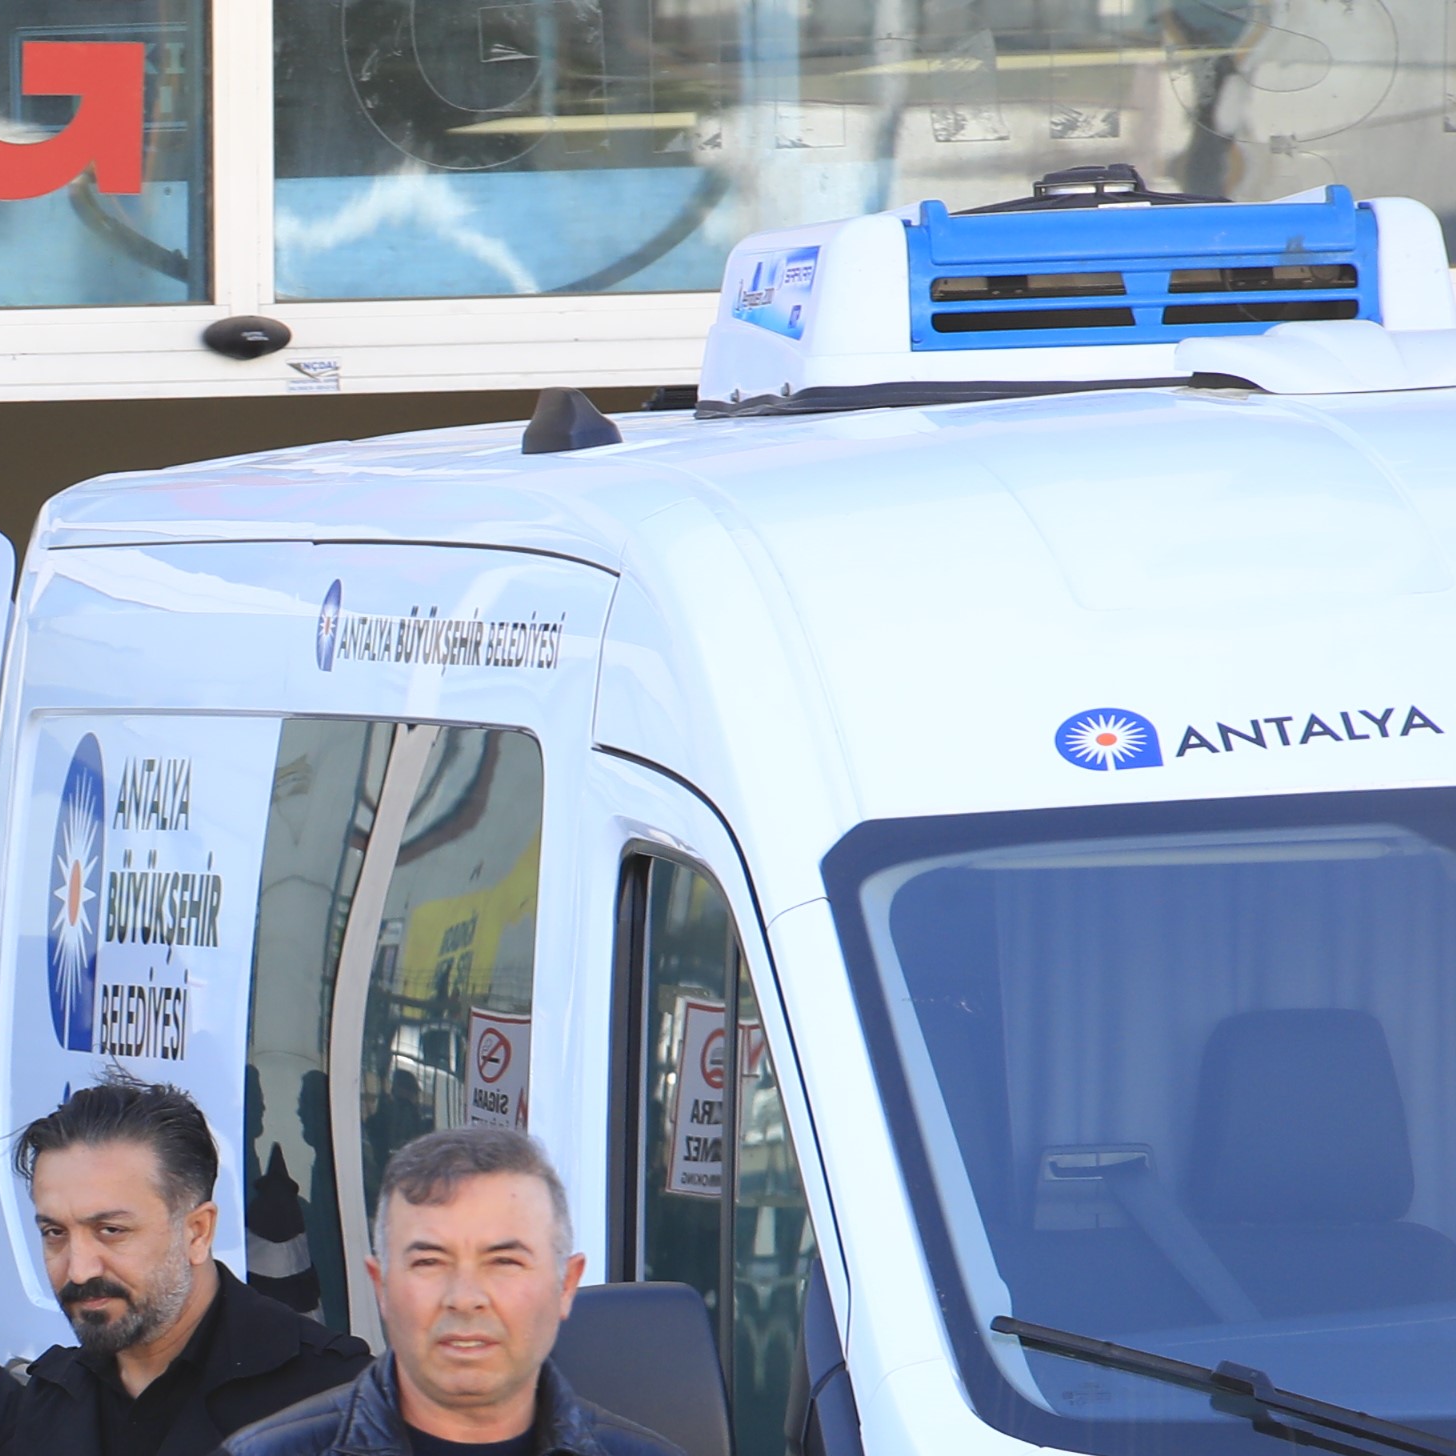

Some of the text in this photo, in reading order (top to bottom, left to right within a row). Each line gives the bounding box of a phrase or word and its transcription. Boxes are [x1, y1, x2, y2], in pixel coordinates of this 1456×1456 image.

[337, 605, 566, 676] ANTALYA BÜYÜKŞEHİR BELEDİYESİ
[1175, 705, 1445, 758] ANTALYA
[113, 756, 191, 832] ANTALYA
[105, 850, 223, 965] BÜYÜKŞEHİR
[100, 967, 189, 1061] BELEDİYESİ
